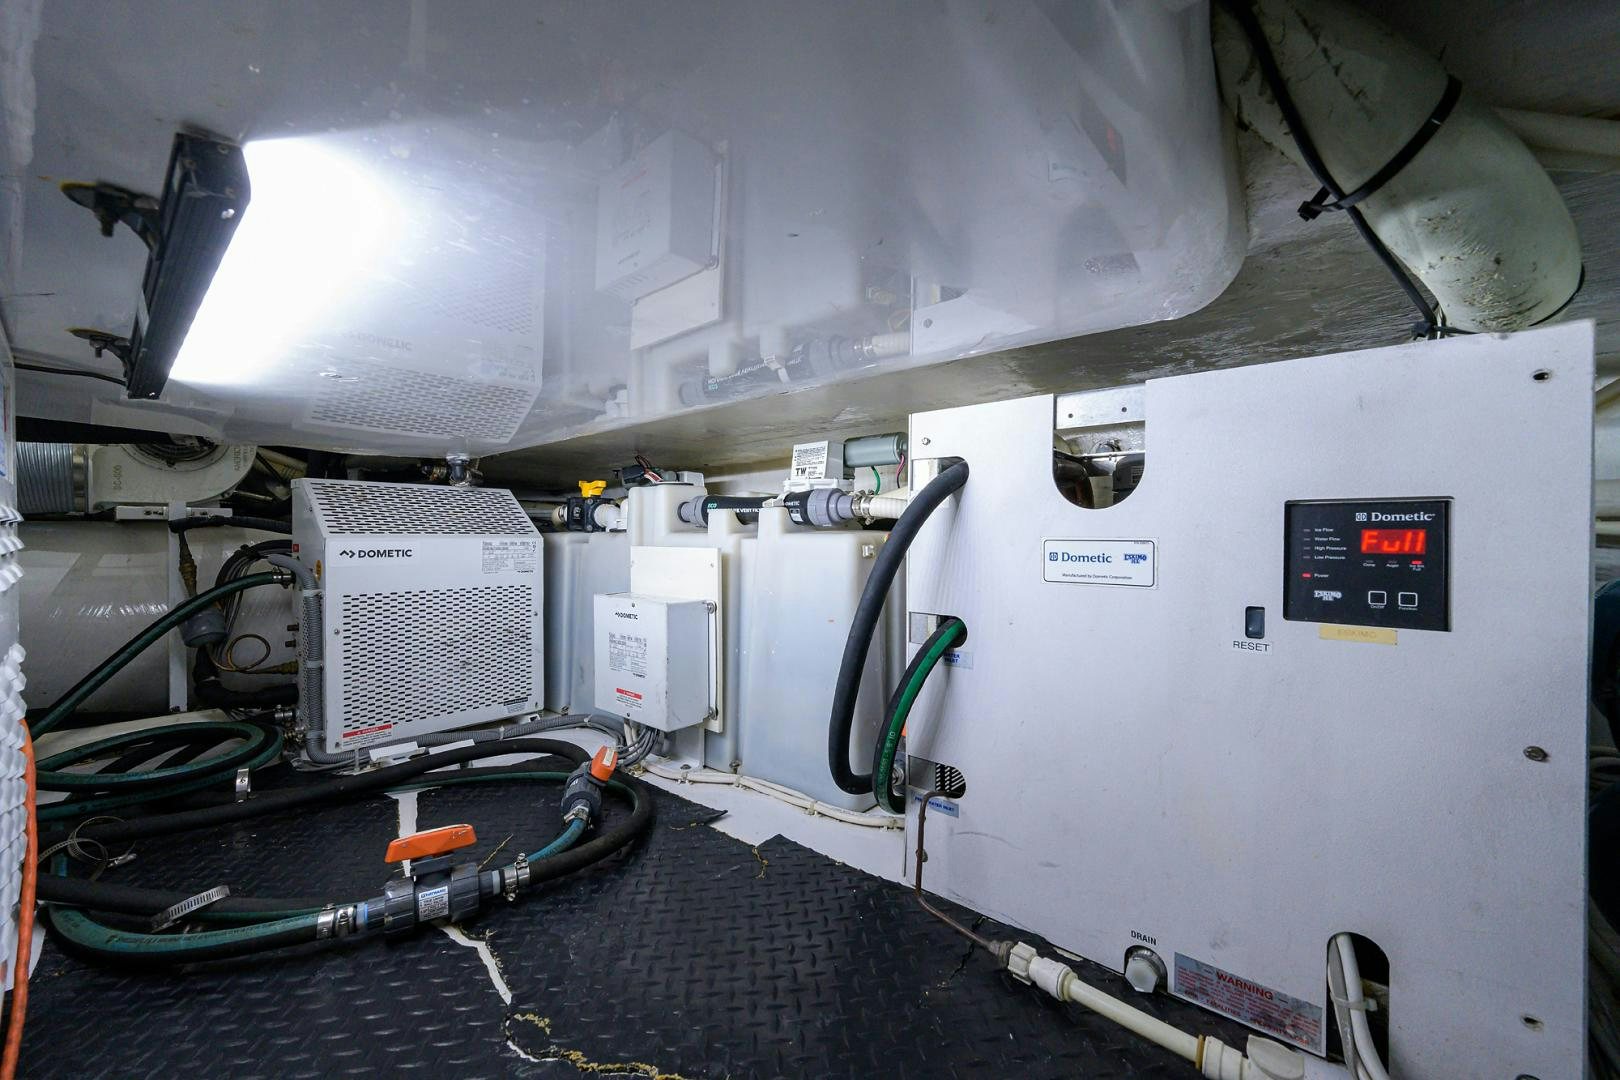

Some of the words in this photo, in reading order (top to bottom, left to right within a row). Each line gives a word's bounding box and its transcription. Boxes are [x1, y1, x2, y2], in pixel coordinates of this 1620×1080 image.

[795, 467, 807, 476] TW
[1371, 511, 1434, 522] Dometic
[1361, 529, 1426, 553] Full
[358, 549, 413, 558] DOMETIC
[1061, 552, 1112, 564] Dometic
[619, 611, 638, 620] DOMETIC
[1233, 640, 1270, 652] RESET
[1130, 929, 1157, 946] DRAIN
[1215, 970, 1274, 1000] WARNING
